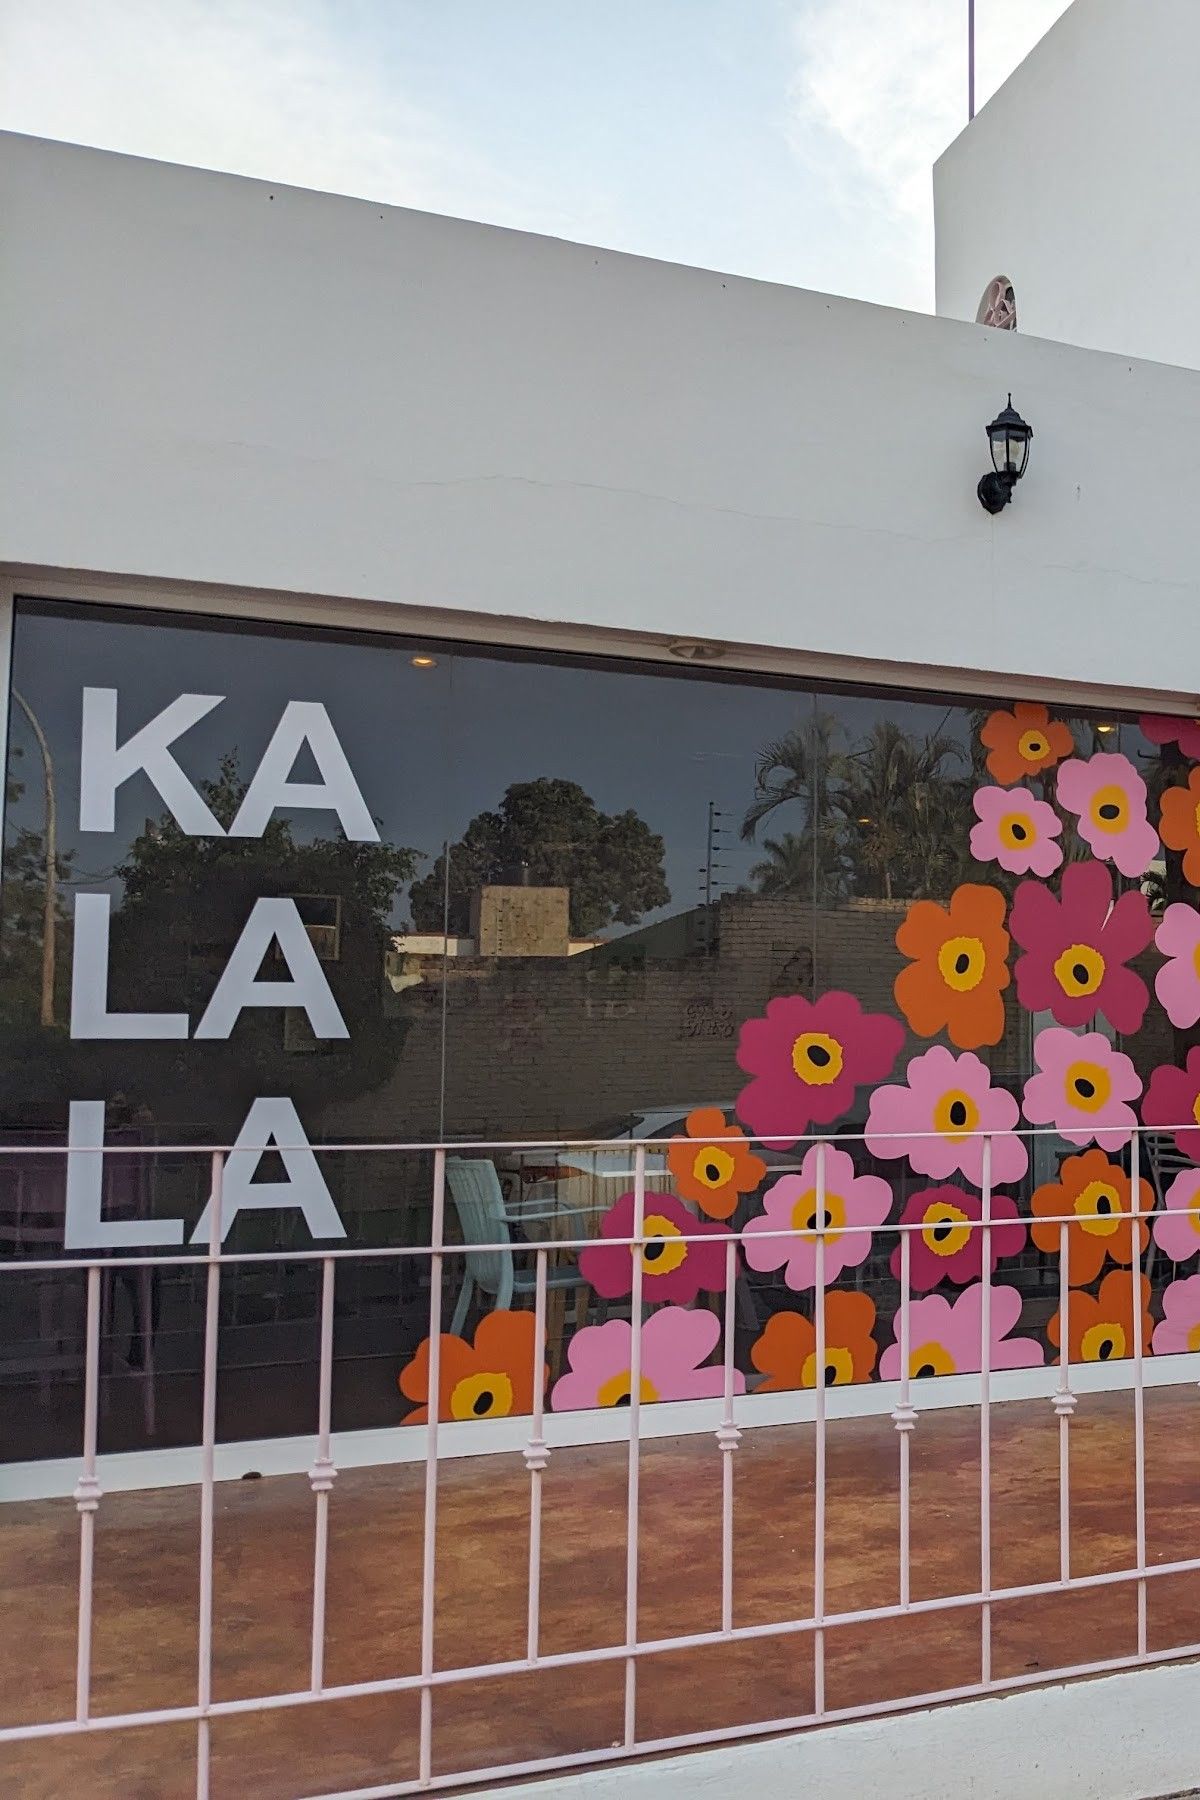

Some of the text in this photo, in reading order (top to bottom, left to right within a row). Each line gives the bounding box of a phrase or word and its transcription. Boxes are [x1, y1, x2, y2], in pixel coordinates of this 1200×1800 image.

[80, 686, 382, 842] KA
[70, 893, 351, 1040] LA
[64, 1097, 348, 1250] LA
